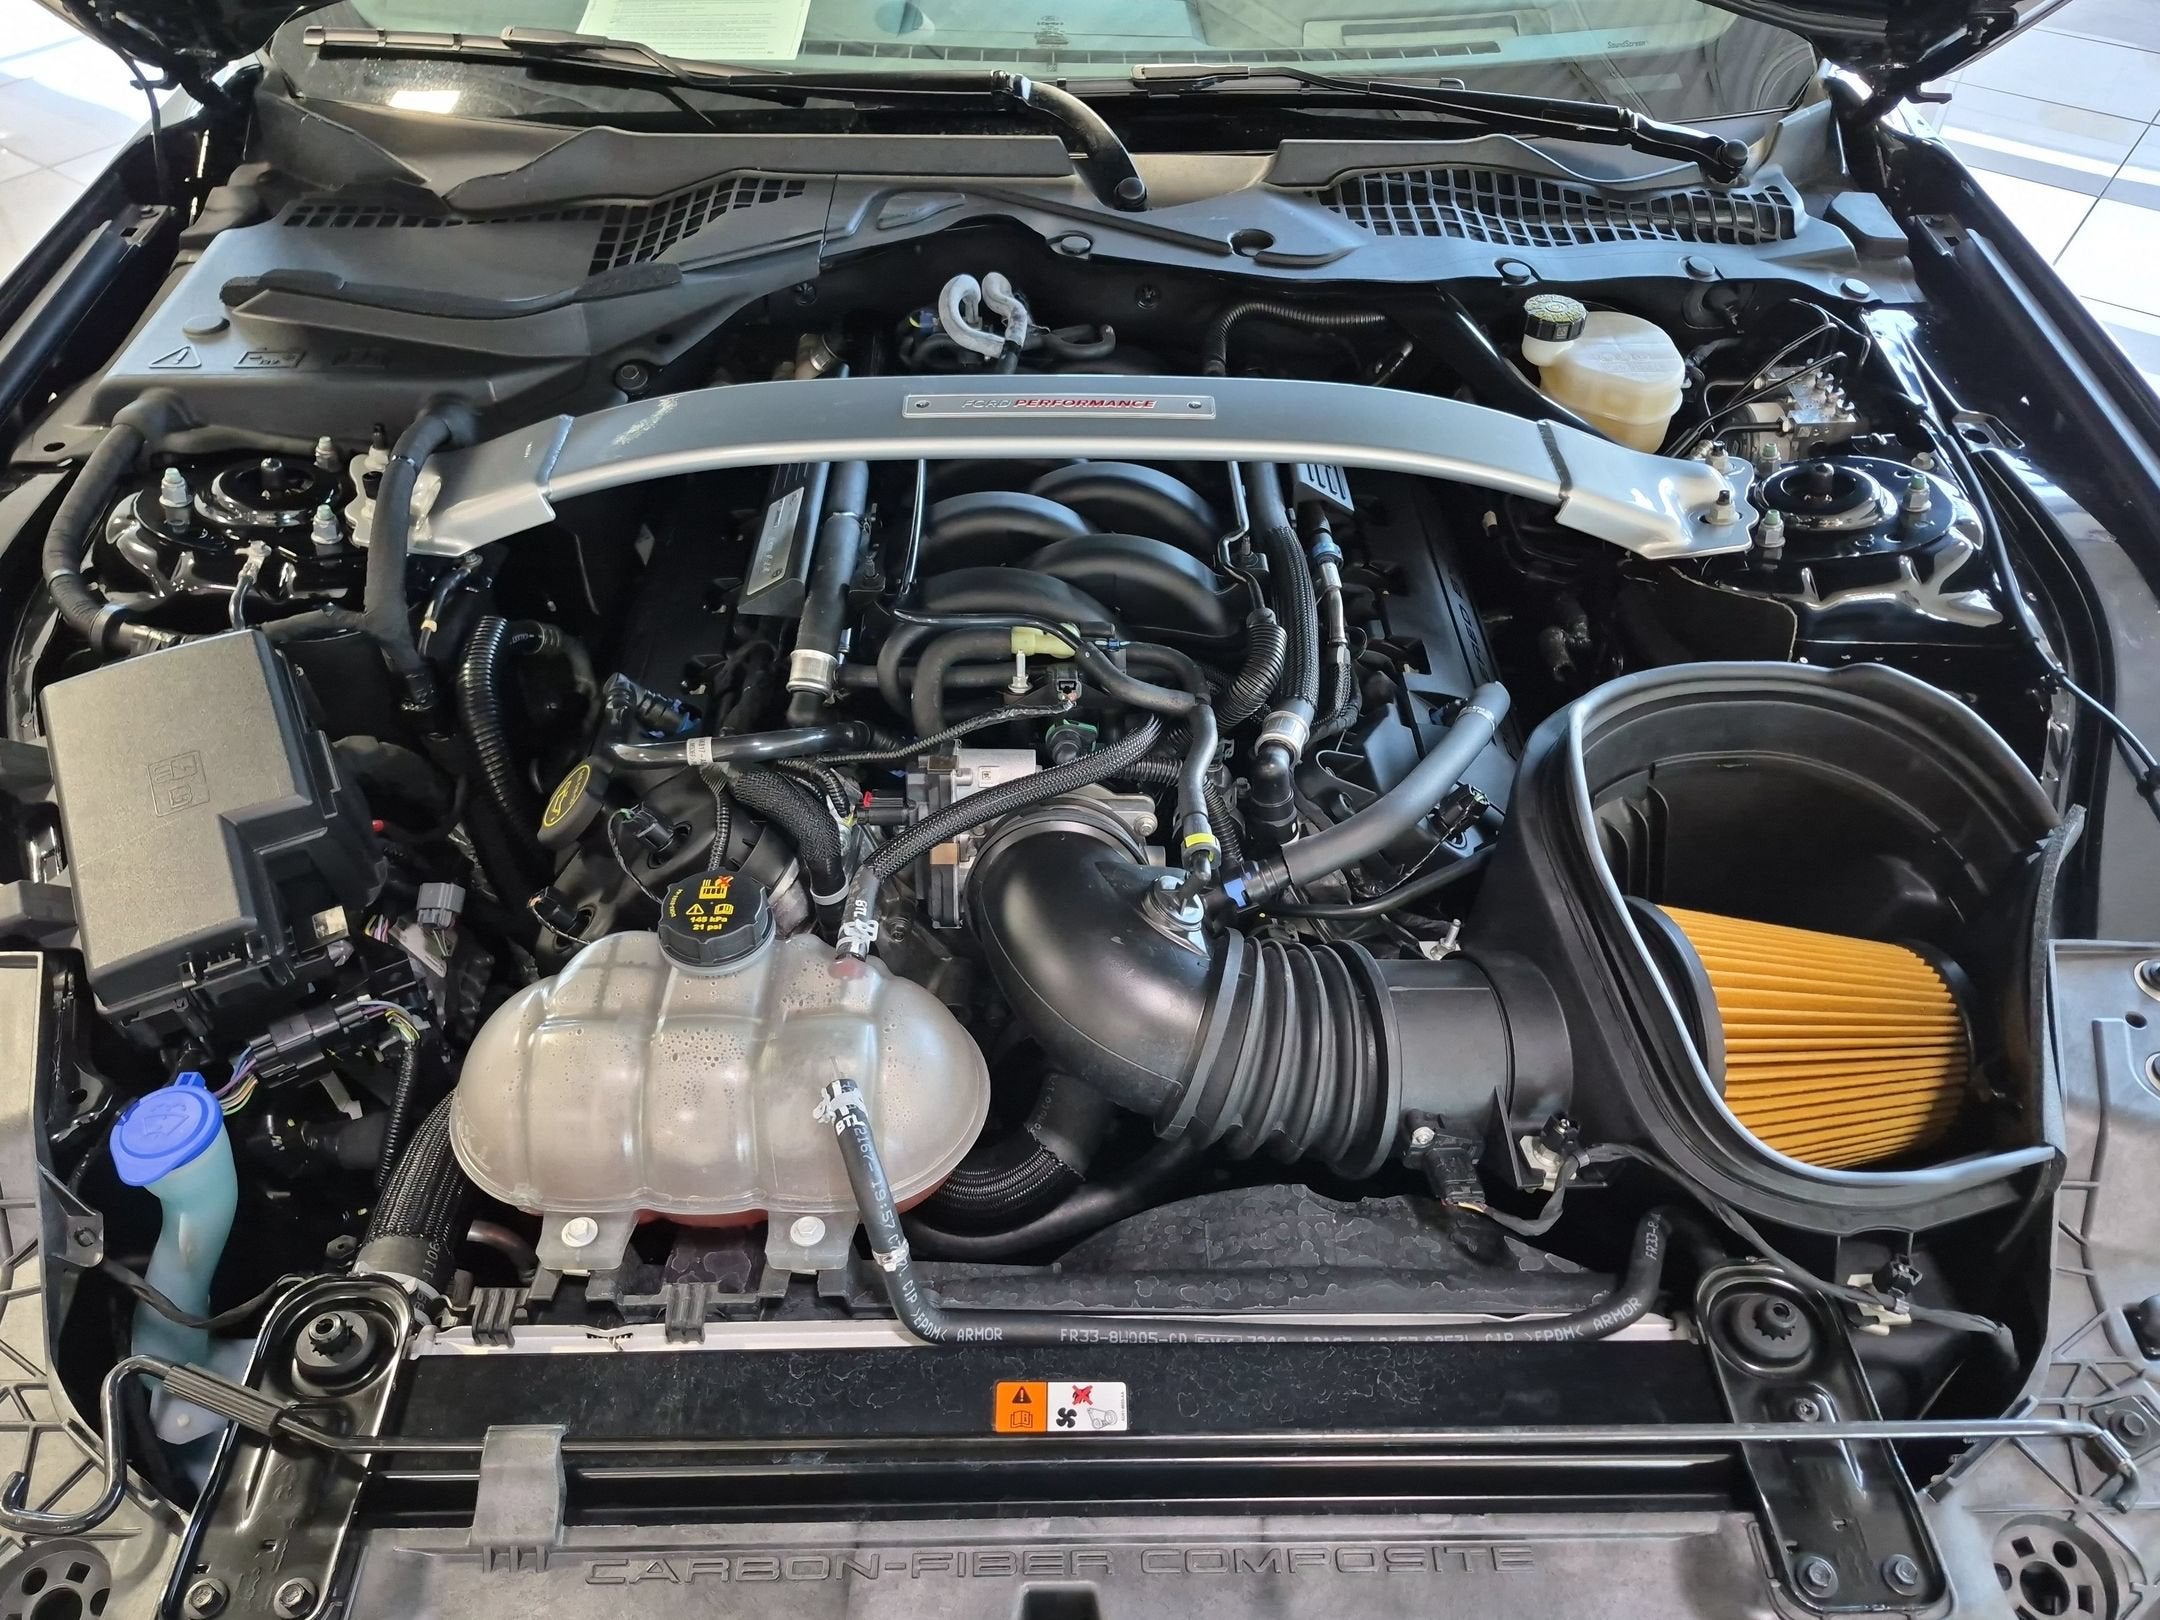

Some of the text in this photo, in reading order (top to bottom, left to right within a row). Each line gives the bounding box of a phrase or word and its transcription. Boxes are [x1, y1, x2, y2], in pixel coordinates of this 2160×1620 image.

[961, 399, 1157, 409] FORD PERFORMANCE
[853, 899, 868, 918] BTL
[835, 1112, 866, 1136] BTL
[1592, 1297, 1643, 1332] ARMOR
[956, 1327, 1003, 1342] ARMOR
[585, 1545, 1536, 1585] CARBON-FIBER COMPOSITE
